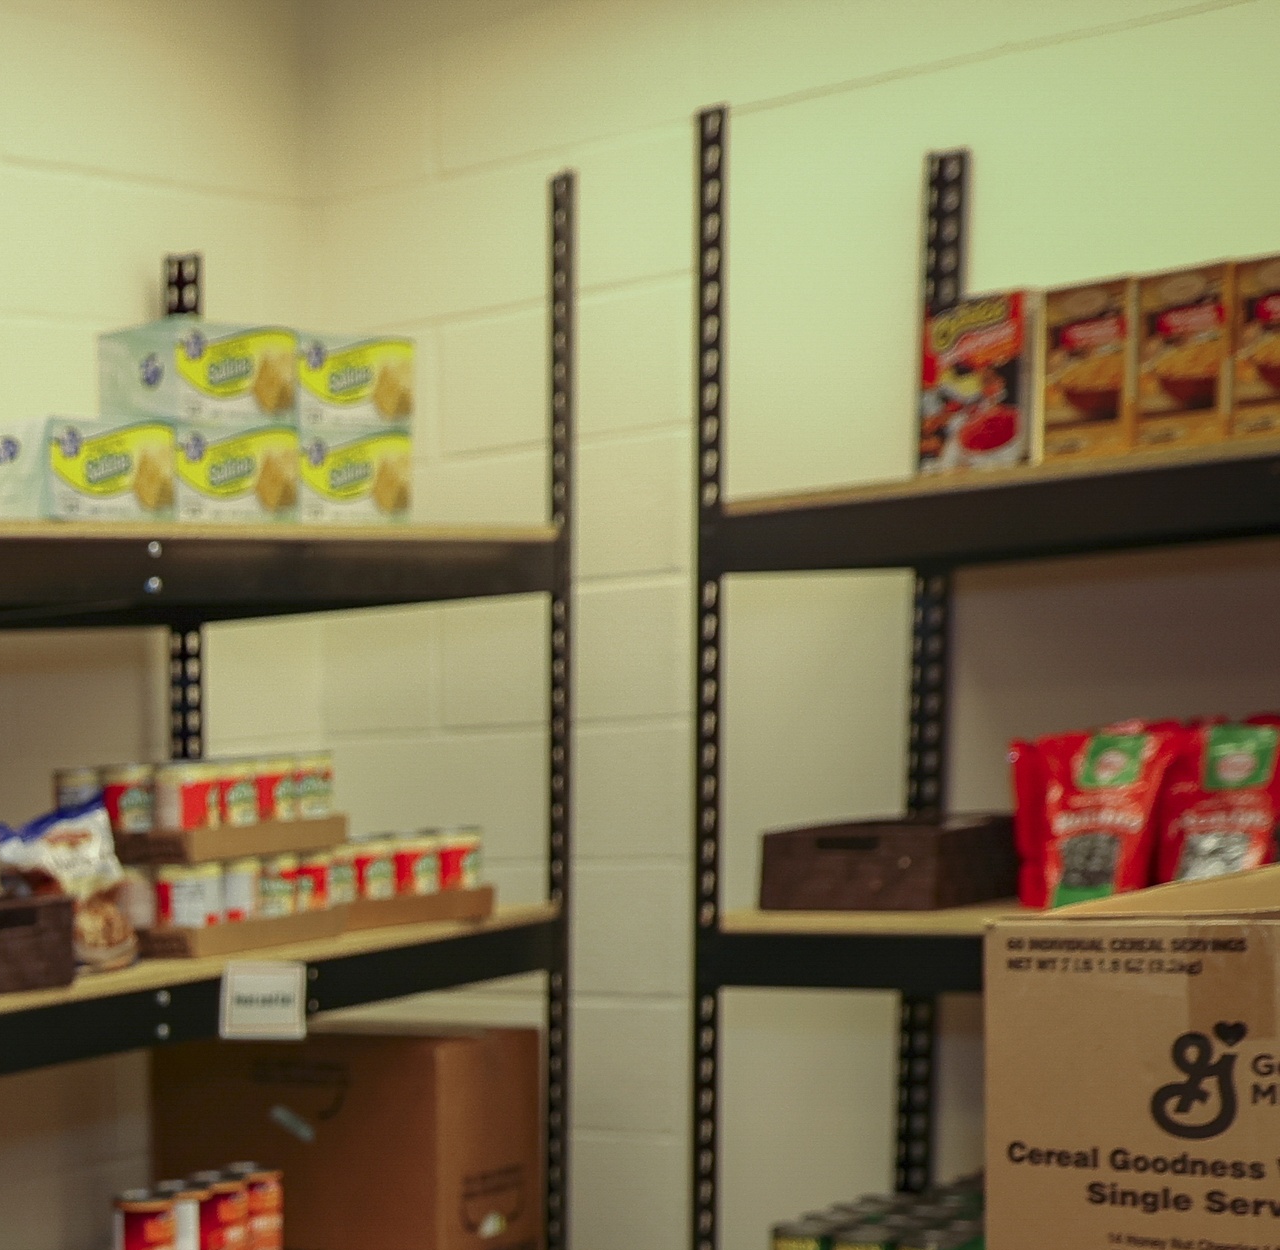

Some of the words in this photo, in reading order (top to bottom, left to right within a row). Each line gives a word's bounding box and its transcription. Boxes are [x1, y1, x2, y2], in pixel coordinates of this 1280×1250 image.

[1008, 1140, 1099, 1170] Cereal
[1110, 1148, 1266, 1179] Goodness
[1087, 1181, 1193, 1214] Single
